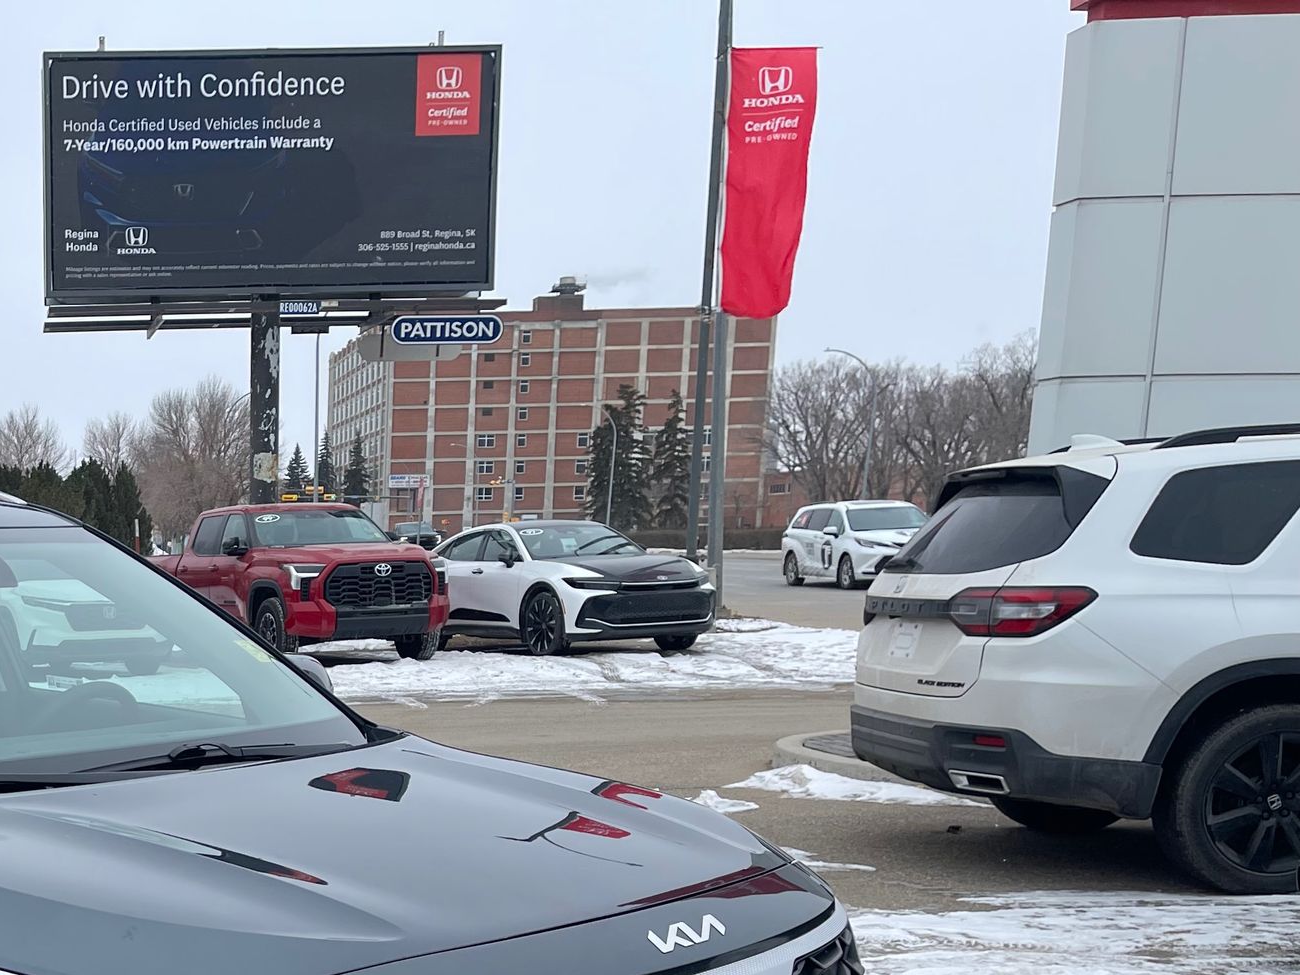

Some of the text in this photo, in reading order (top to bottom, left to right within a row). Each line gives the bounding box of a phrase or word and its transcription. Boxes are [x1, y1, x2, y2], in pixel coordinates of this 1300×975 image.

[62, 70, 345, 99] Drive with Confidence
[426, 91, 471, 99] HONDA
[742, 94, 805, 108] HONDA
[428, 106, 469, 119] Certified
[63, 115, 322, 132] Honda Certified Used Vehicles include a
[744, 115, 800, 132] Certified
[63, 135, 335, 153] 7-Year/160,000 km Powertrain Warranty
[745, 132, 798, 144] PRE-OWNED
[64, 228, 99, 241] Regina
[380, 230, 396, 239] 889
[397, 229, 420, 239] Broad
[465, 228, 476, 237] SK
[65, 241, 99, 252] Honda
[116, 247, 157, 255] HONDA
[414, 241, 476, 252] reginahonda.ca
[400, 321, 494, 338] PATTISON
[647, 913, 727, 954] KIA
